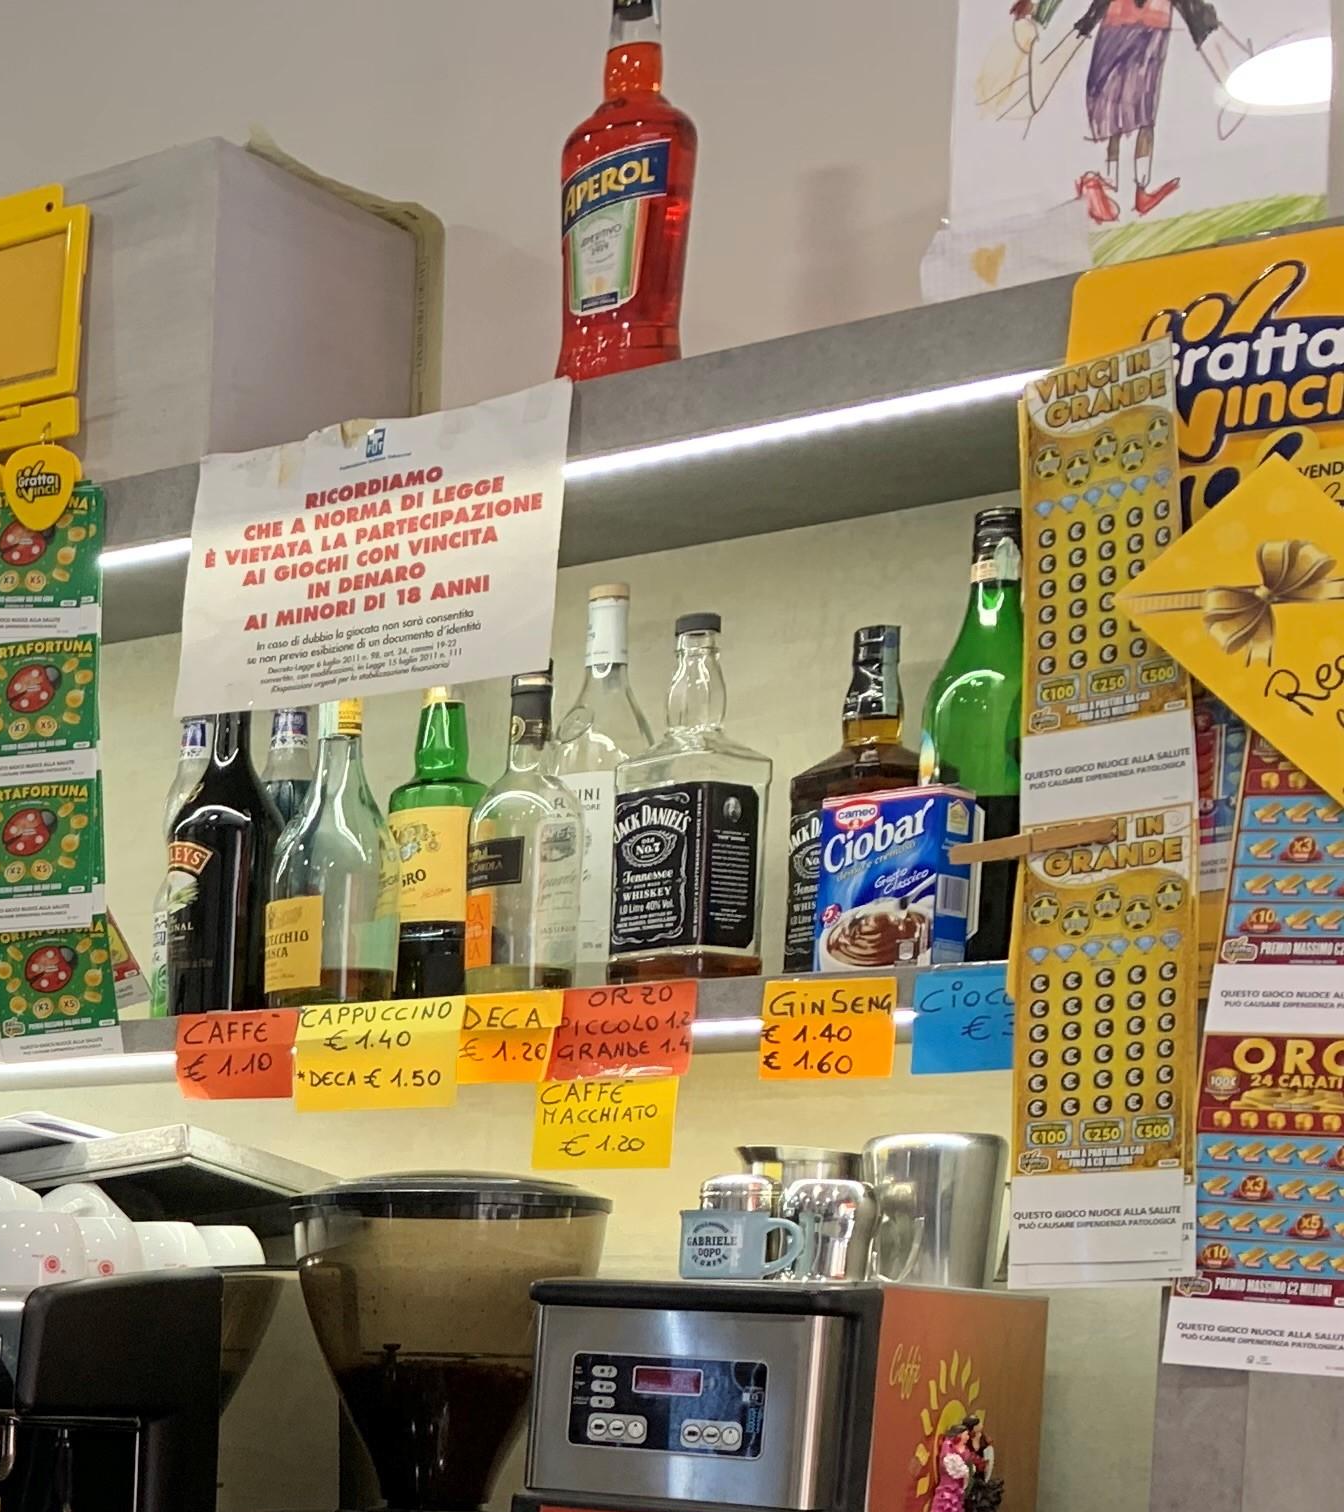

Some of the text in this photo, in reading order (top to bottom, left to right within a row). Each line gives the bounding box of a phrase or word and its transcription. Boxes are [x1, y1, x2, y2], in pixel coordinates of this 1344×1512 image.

[564, 157, 655, 223] APEROL
[1174, 321, 1344, 387] ratta
[1033, 350, 1151, 404] VINCI IN
[1045, 373, 1168, 428] GRANDE
[306, 466, 443, 509] RICORDIAMO
[244, 476, 504, 541] CHE A NORMA DI LEGGE
[205, 493, 543, 568] È VIETATA LA PARTECIPAZIONE
[243, 526, 498, 586] AI GIOCHI CON VINCITA
[308, 562, 426, 599] IN DENARO
[244, 575, 490, 631] AI MINORI DI 18 ANNI
[838, 806, 876, 819] cameo
[614, 811, 641, 844] JACK
[823, 799, 934, 873] Ciobar
[1043, 837, 1182, 878] GRANDE
[623, 869, 674, 885] Tennessee
[623, 886, 672, 901] WHISKEY
[588, 985, 673, 1007] ORZO
[302, 1003, 454, 1028] CAPPUCCINO
[463, 1006, 543, 1031] DECA
[556, 1015, 659, 1037] PICCOLO
[962, 1016, 990, 1040] €
[323, 1029, 412, 1051] € 1.40
[763, 1024, 852, 1044] € 1.40
[458, 1041, 548, 1062] € 1.20
[557, 1038, 651, 1061] GRANDE
[183, 1052, 273, 1083] € 1.10
[763, 1051, 853, 1074] € 1.60
[542, 1103, 658, 1126] MACCHIATO
[559, 1133, 645, 1155] € 1.20
[1013, 1211, 1052, 1219] QUESTO
[1055, 1210, 1086, 1218] GIOCO
[1089, 1209, 1121, 1217] NUOCE
[1149, 1206, 1181, 1214] SALUTE
[687, 1235, 737, 1246] GABRIELE
